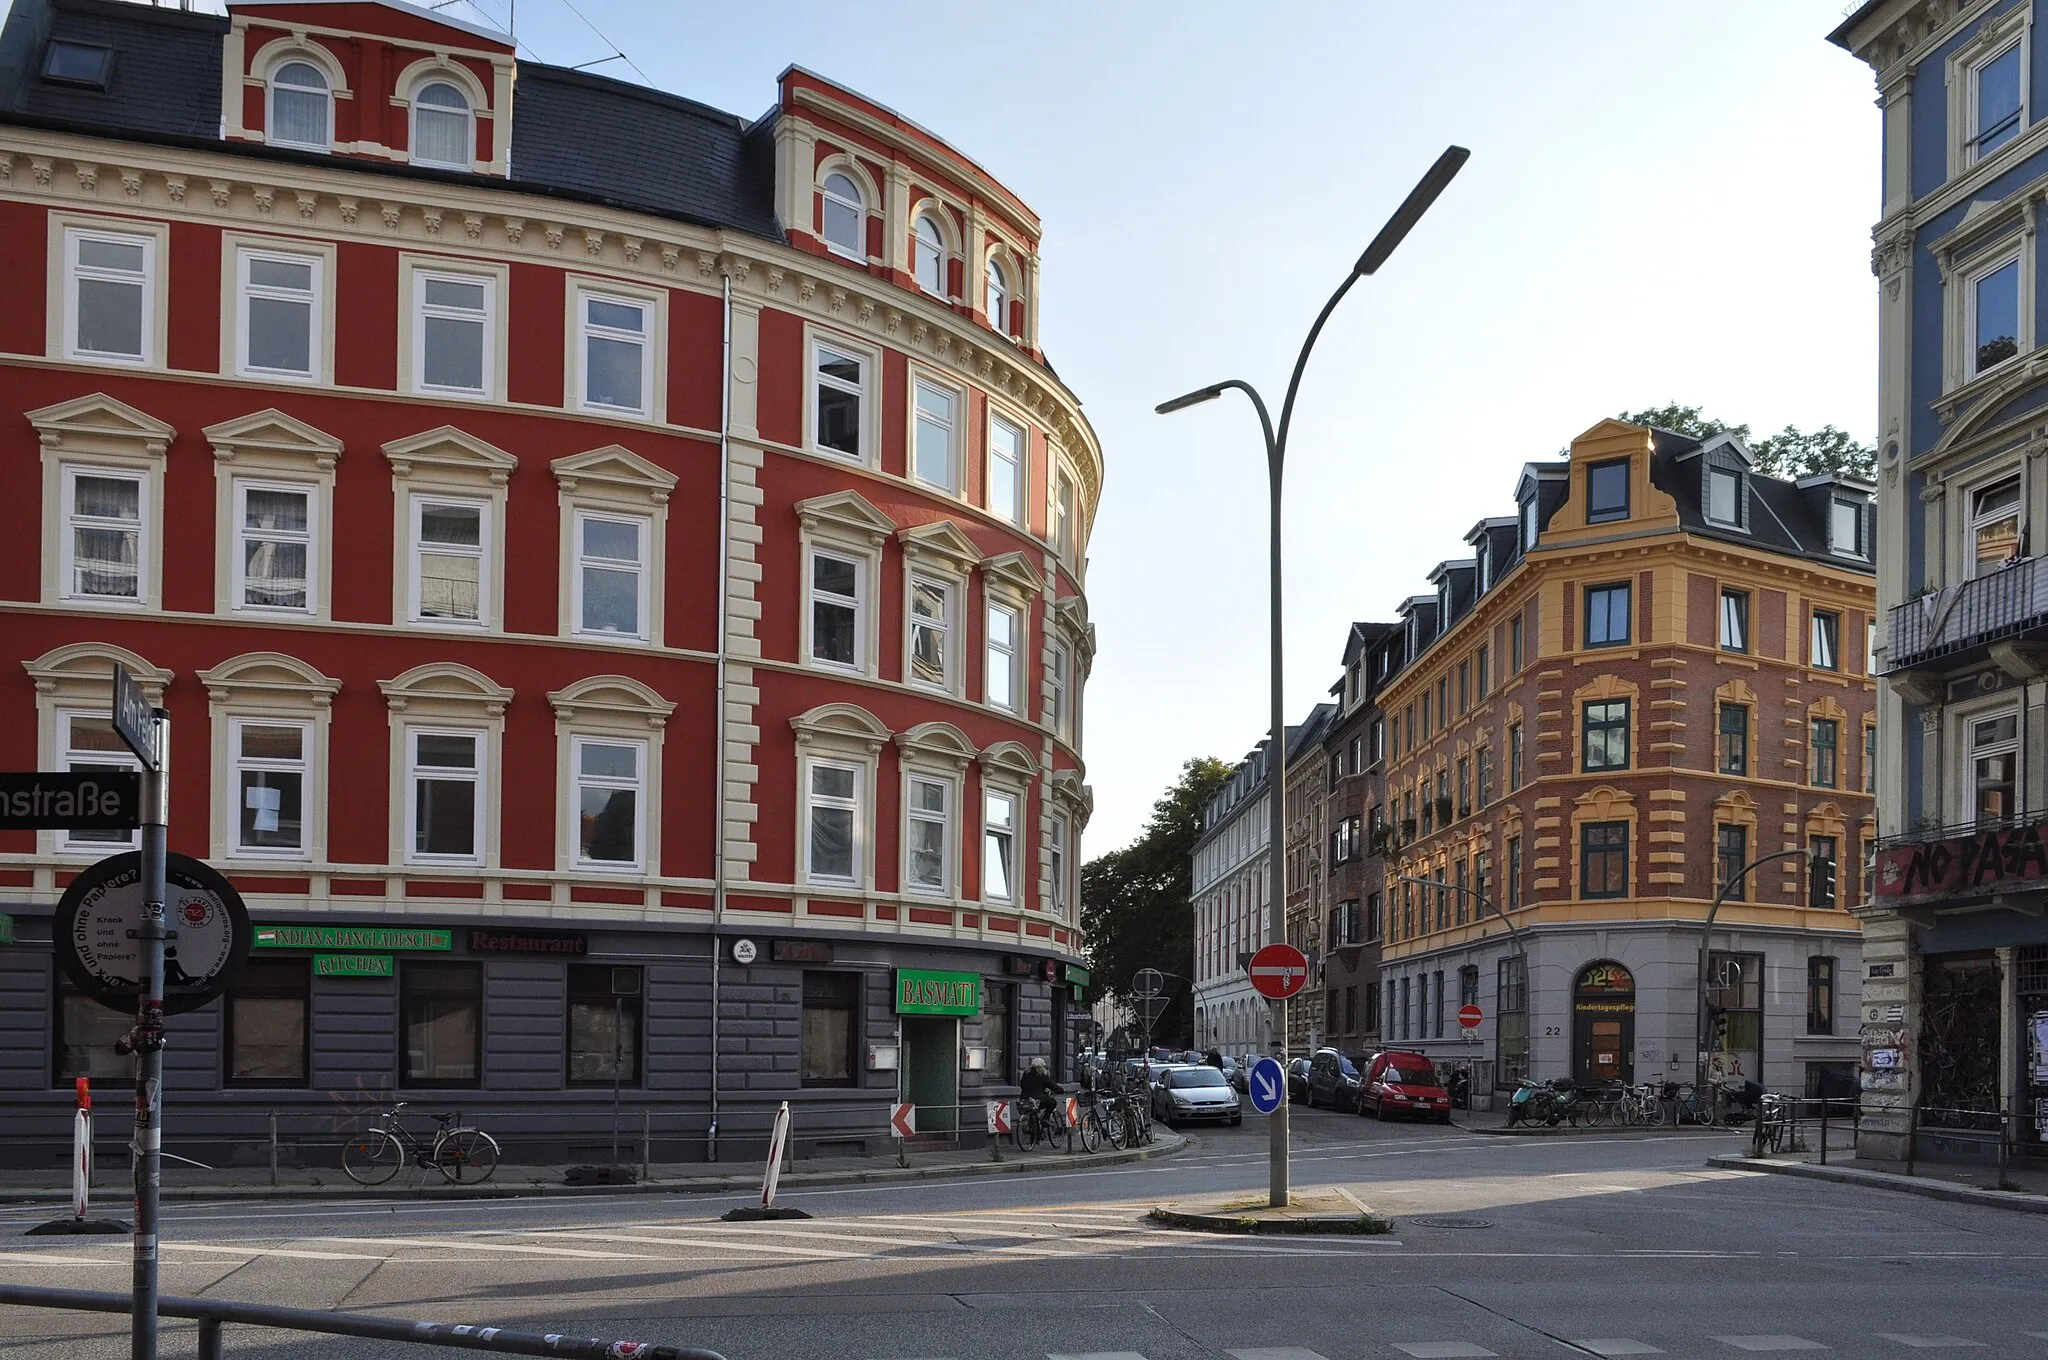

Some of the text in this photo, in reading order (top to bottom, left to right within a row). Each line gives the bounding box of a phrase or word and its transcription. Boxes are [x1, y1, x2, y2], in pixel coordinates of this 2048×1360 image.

[1903, 842, 1953, 894] NO
[83, 868, 137, 908] Papiere?
[74, 910, 90, 941] ohne
[275, 929, 433, 948] INDIAN & BANGLADESCH
[471, 931, 584, 953] Restaurant
[77, 944, 98, 968] und
[97, 953, 137, 961] Papiere?
[319, 955, 388, 974] KITCHEN
[902, 979, 976, 1006] BASMATI
[1546, 1026, 1561, 1036] 22
